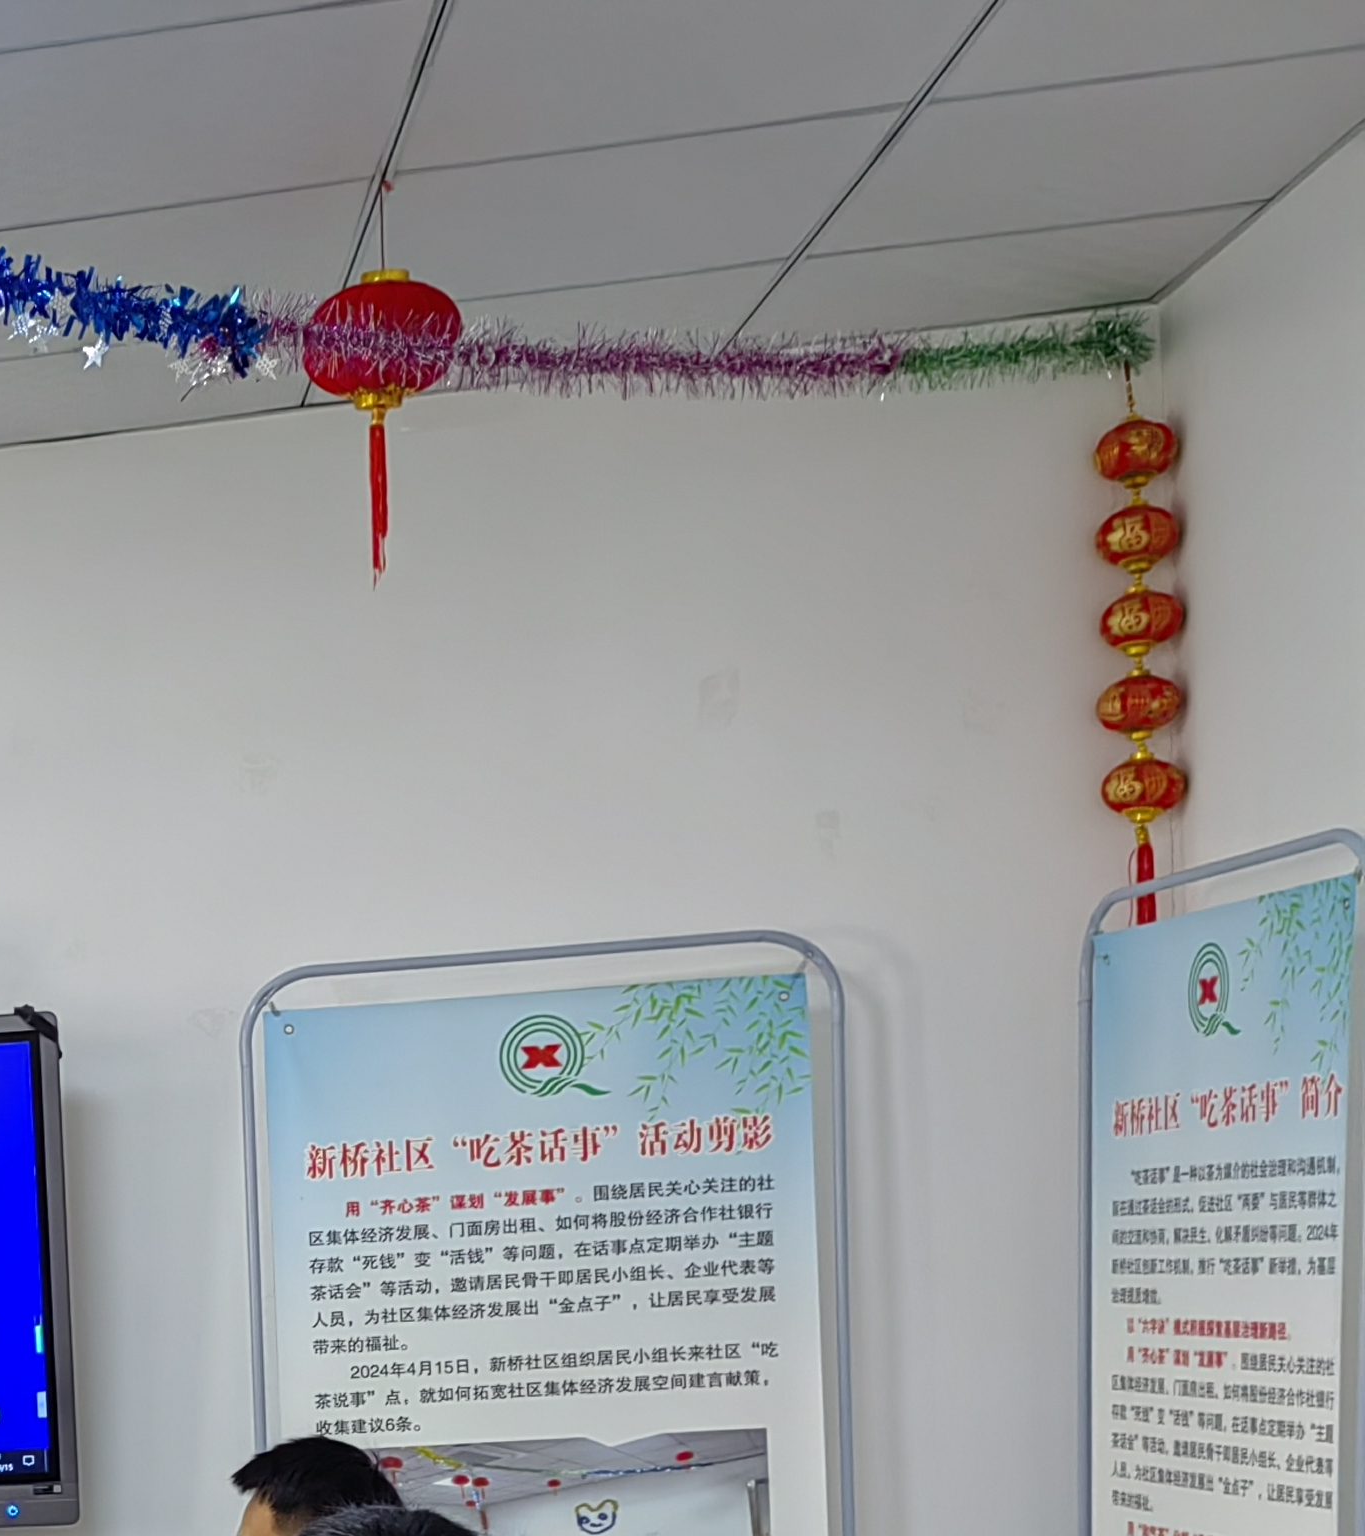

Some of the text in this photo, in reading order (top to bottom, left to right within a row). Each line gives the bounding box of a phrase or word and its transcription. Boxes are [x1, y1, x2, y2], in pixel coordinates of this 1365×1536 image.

[1112, 1072, 1343, 1138] 新桥社区“吃茶话事”简介
[305, 1114, 773, 1181] 新桥社区“吃茶话事”活动剪影
[309, 1202, 773, 1247] 区集体经济发展、门面房出租、如何将股份经济合作社银行
[309, 1230, 775, 1275] 存款“死钱”变“活钱”等问题，在话事点定期举办“主题
[309, 1257, 775, 1302] 茶话会”等活动，邀请居民骨干即居民小组长、企业代表等
[311, 1285, 776, 1329] 人员，为社区集体经济发展出“金点子”，让居民享受发展
[312, 1335, 408, 1355] 带来的福祉。
[350, 1341, 779, 1380] 2024年4月15日，新桥社区组织居民小组长来社区“吃
[315, 1416, 421, 1437] 收集建议6条。
